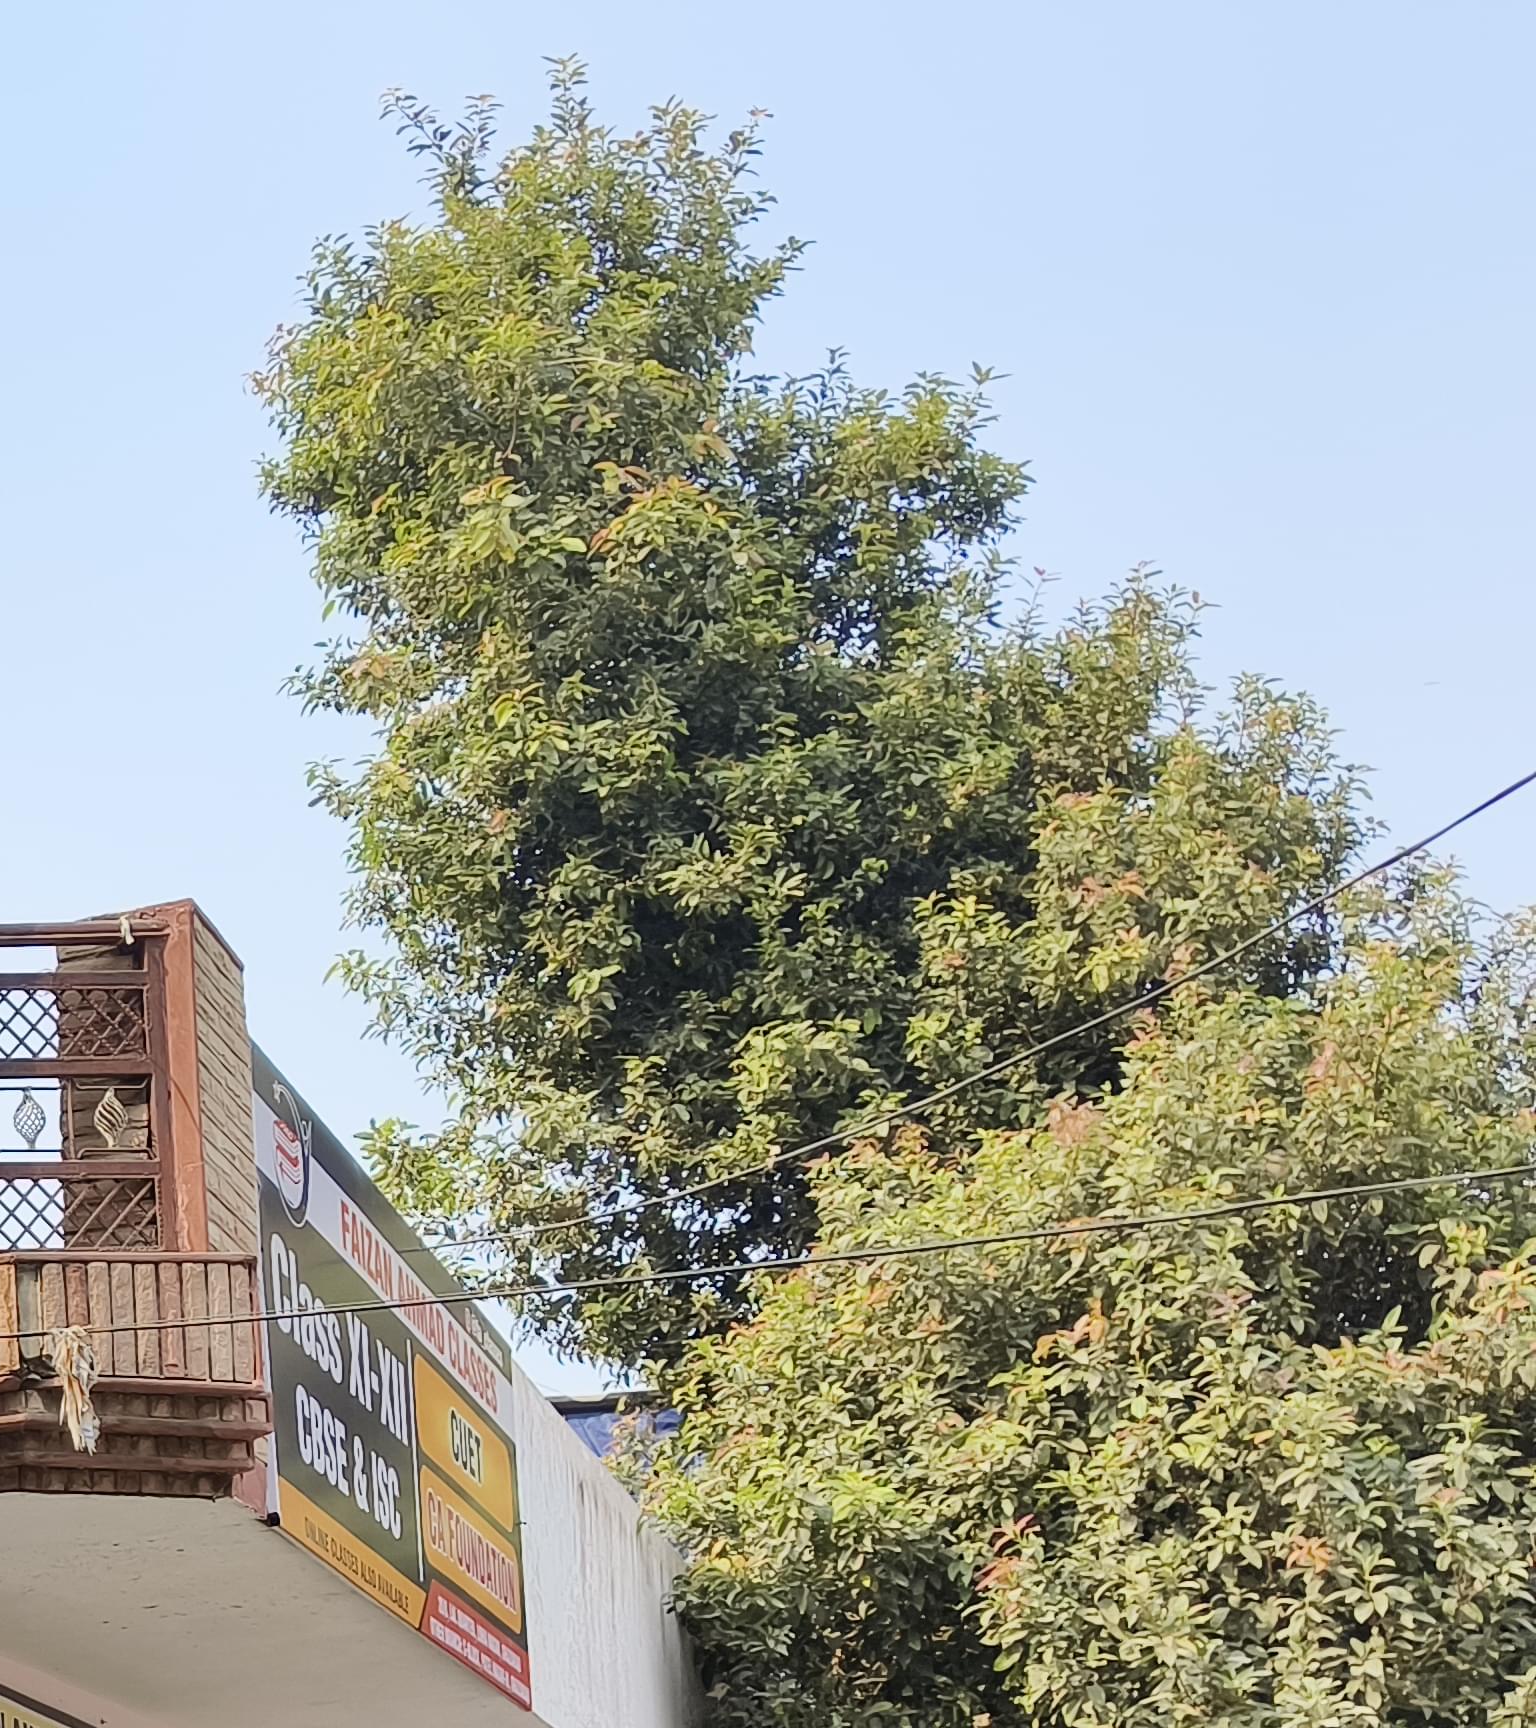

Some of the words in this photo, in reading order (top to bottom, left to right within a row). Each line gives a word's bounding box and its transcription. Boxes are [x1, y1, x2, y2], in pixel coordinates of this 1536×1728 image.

[270, 1233, 343, 1384] Class
[346, 1311, 410, 1446] XI-XII
[340, 1200, 394, 1302] FAIZAN
[448, 1321, 498, 1414] CLASSES
[295, 1383, 350, 1496] CBSE
[353, 1435, 369, 1514] &
[371, 1450, 402, 1540] ISC
[451, 1409, 482, 1484] CUET
[447, 1506, 517, 1612] FOUNDATION
